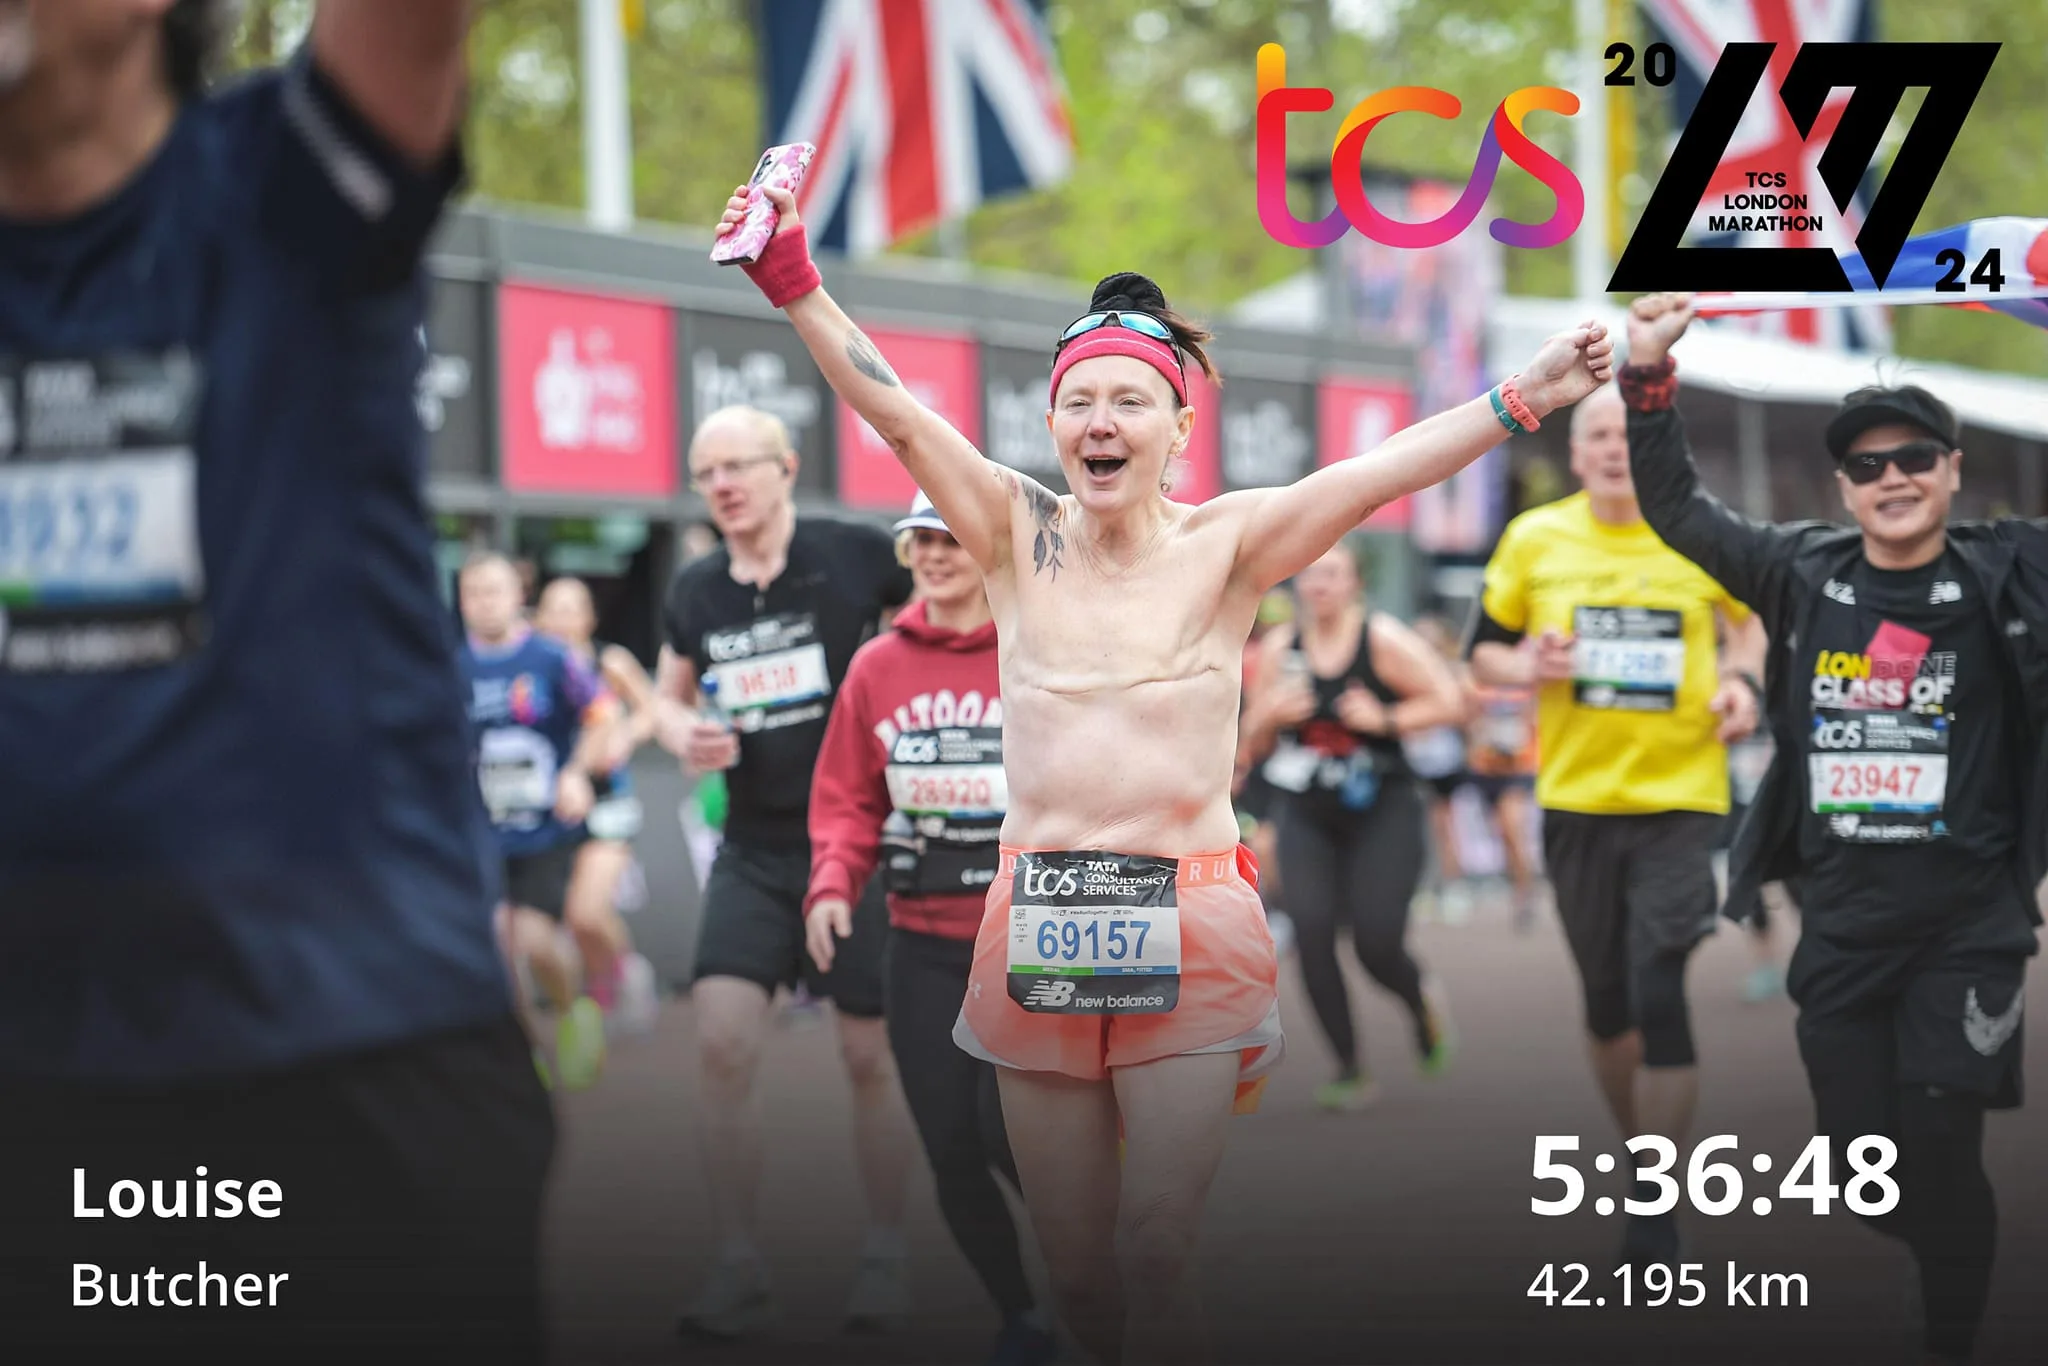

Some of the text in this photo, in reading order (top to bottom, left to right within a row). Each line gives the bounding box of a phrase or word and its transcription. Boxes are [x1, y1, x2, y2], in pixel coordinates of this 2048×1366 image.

[1811, 674, 1955, 706] CLASS OF
[1830, 764, 1923, 798] 23947
[1085, 860, 1120, 874] TATA
[1024, 863, 1079, 896] tcs
[1082, 884, 1138, 896] SERVICES
[1084, 872, 1169, 887] CONSULTANCY
[1037, 920, 1152, 961] 69157
[1075, 997, 1104, 1008] new
[1106, 995, 1164, 1008] balance
